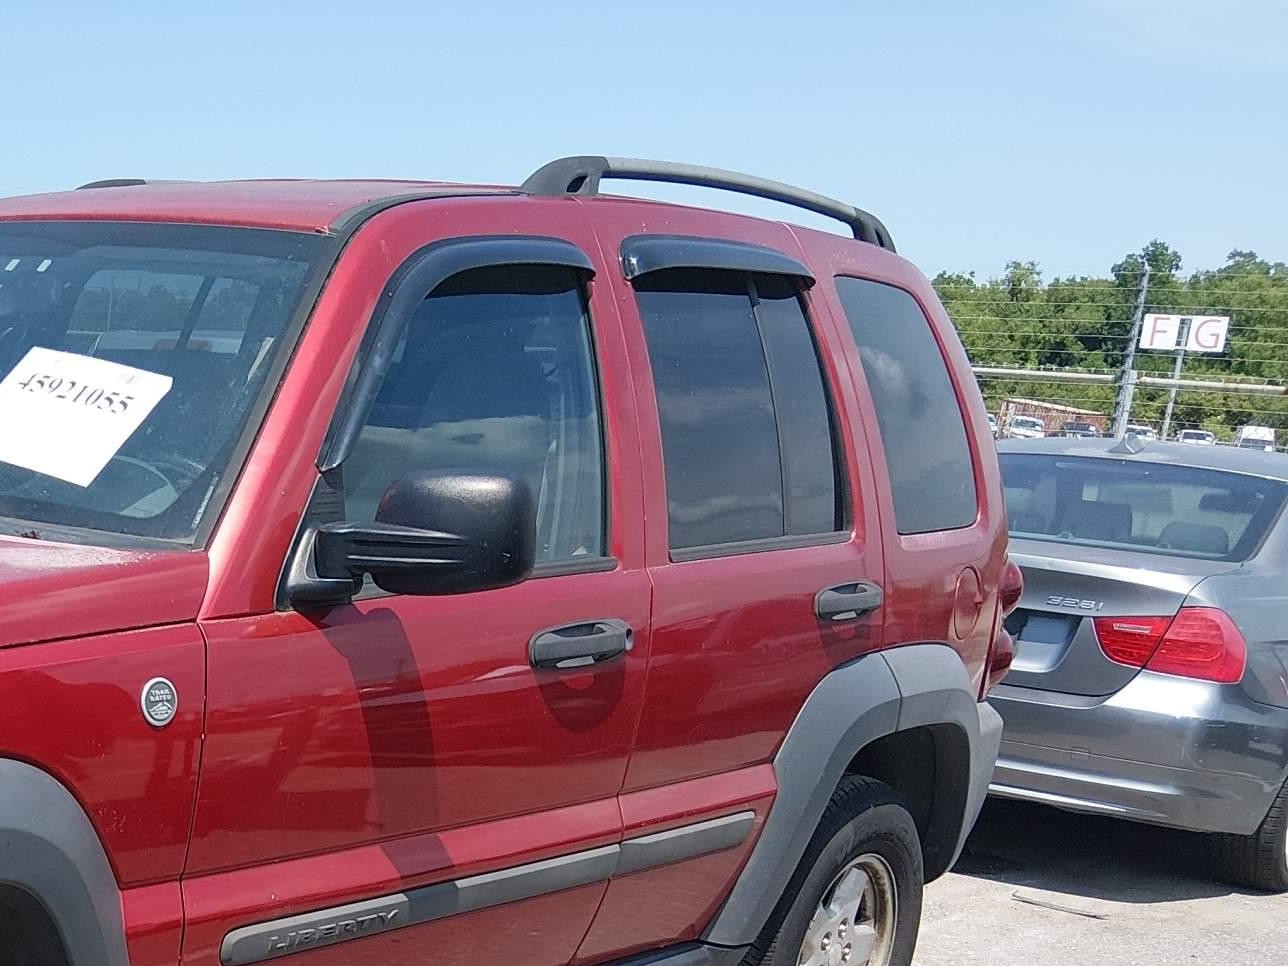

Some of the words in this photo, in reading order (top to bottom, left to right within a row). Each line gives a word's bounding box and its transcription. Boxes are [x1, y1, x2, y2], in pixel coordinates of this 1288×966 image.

[1149, 316, 1171, 347] F
[1194, 318, 1222, 349] G
[18, 372, 135, 415] 45921055
[265, 908, 400, 952] LIBERTY
